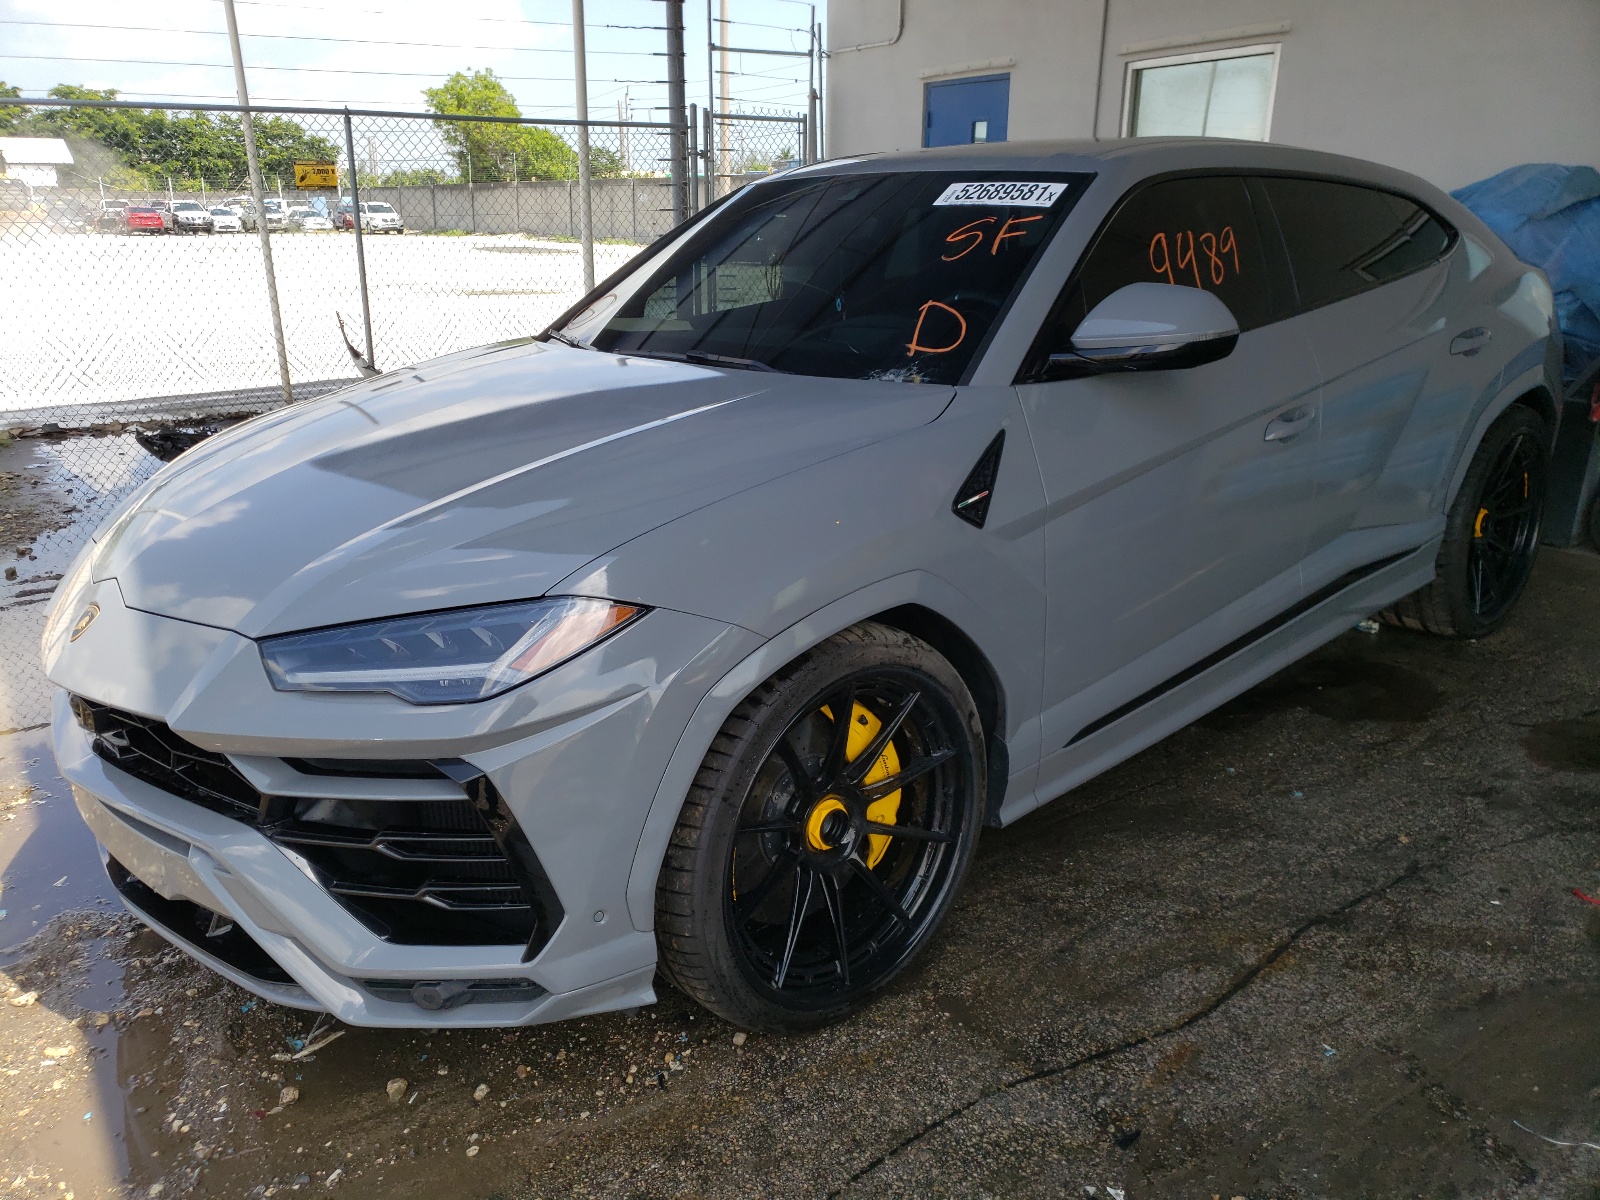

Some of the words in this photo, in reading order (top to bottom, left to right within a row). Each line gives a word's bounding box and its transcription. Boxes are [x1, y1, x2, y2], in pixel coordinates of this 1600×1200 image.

[941, 214, 1043, 261] SF
[1149, 226, 1239, 289] 9489
[904, 299, 967, 357] D
